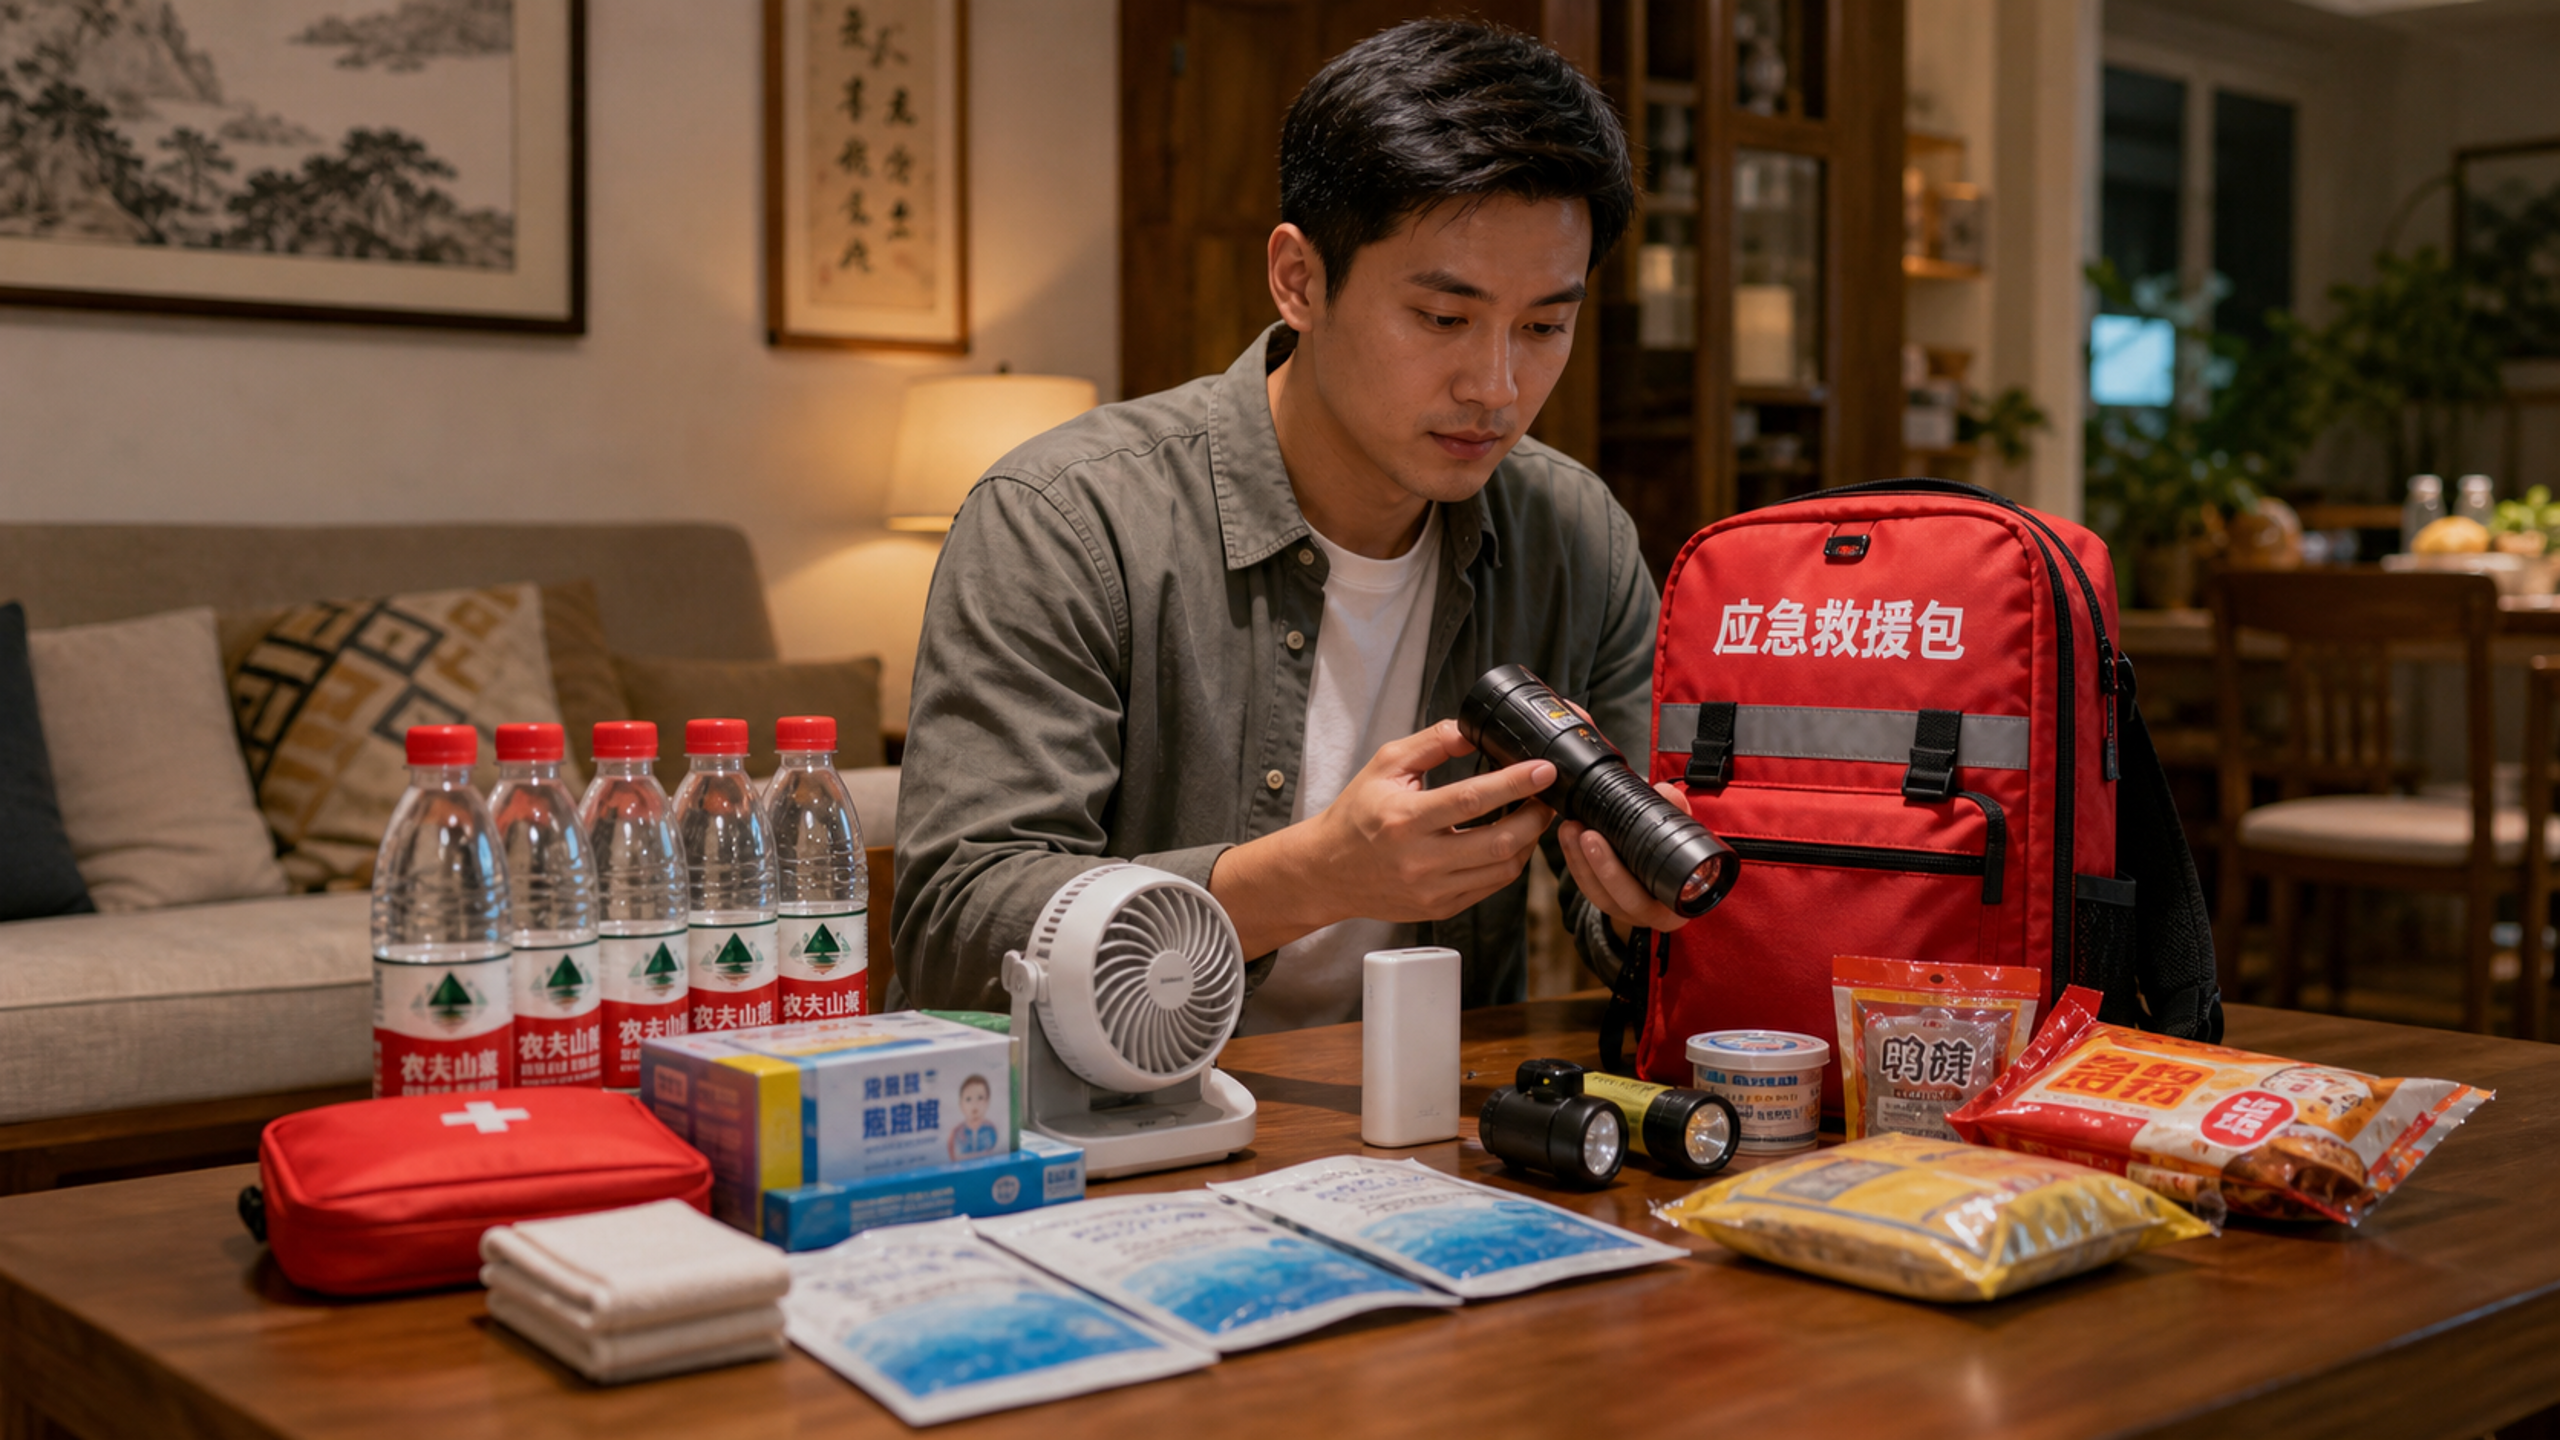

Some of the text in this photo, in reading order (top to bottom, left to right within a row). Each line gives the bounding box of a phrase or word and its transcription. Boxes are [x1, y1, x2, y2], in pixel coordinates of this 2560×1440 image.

[1713, 598, 1965, 660] 应急救援包
